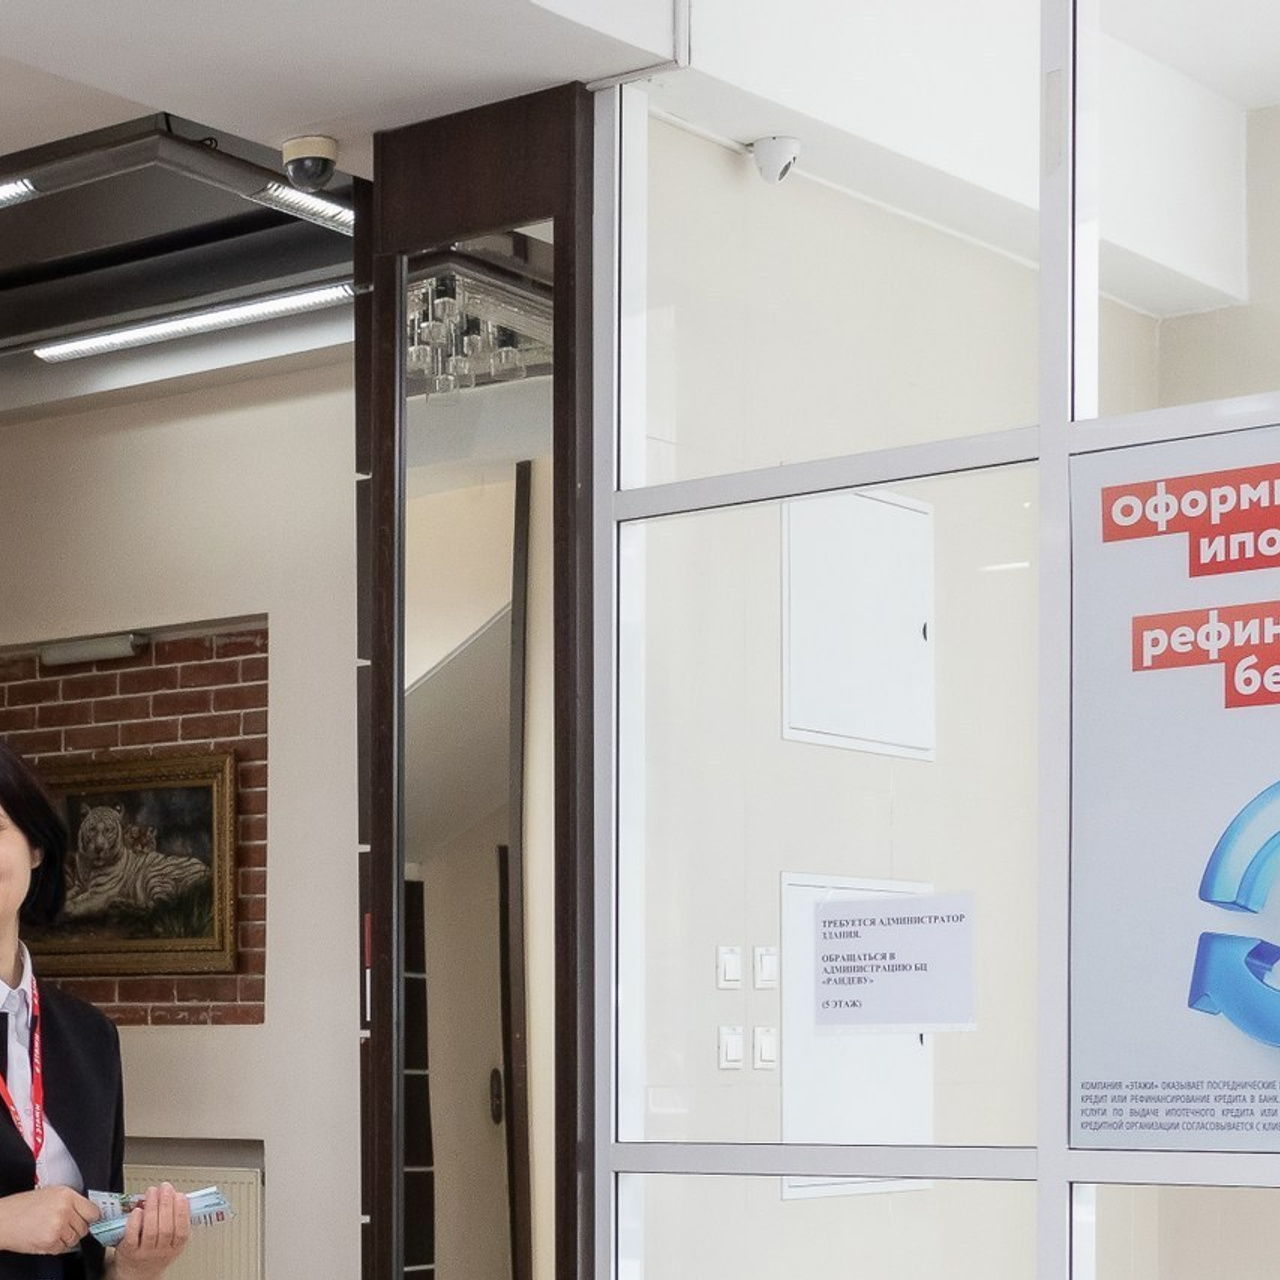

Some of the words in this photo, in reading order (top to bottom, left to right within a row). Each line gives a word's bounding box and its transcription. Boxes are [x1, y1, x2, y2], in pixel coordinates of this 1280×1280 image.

[1111, 480, 1280, 531] Оформ
[822, 918, 876, 928] ТРЕБУЕТСЯ
[879, 914, 965, 927] АДМИНИСТРАТОР
[821, 953, 888, 963] ОБРАЩАТЬСЯ
[889, 952, 896, 961] В
[822, 964, 912, 975] АДМИНИСТРАЦИЮ
[914, 962, 928, 972] БЦ
[821, 976, 874, 986] «РАНДЕВУ»
[821, 999, 831, 1009] (5
[832, 999, 862, 1009] ЭТАЖ)
[1080, 1081, 1123, 1090] КОМПАНИЯ
[1124, 1081, 1159, 1090] «ЭТАЖИ»
[1160, 1081, 1204, 1090] ОКАЗЫВАЕТ
[1207, 1081, 1276, 1091] ПОСРЕДНИЧЕСКИЕ
[1080, 1095, 1108, 1104] КРЕДИТ
[1111, 1095, 1127, 1104] ИЛИ
[1130, 1095, 1212, 1104] РЕФИНАНСИРОВАНИЕ
[1214, 1095, 1247, 1105] КРЕДИТА
[1250, 1095, 1255, 1104] В
[1080, 1108, 1108, 1118] УСЛУГИ
[1112, 1108, 1124, 1117] ПО
[1129, 1108, 1159, 1118] ВЫДАЧЕ
[1165, 1108, 1216, 1117] ИПОТЕЧНОГО
[1221, 1108, 1255, 1118] КРЕДИТА
[1260, 1108, 1279, 1117] ИЛИ
[1080, 1120, 1125, 1131] КРЕДИТНОЙ
[1125, 1121, 1180, 1131] ОРГАНИЗАЦИИ
[1181, 1121, 1255, 1131] СОГЛАСОВЫВАЕТСЯ
